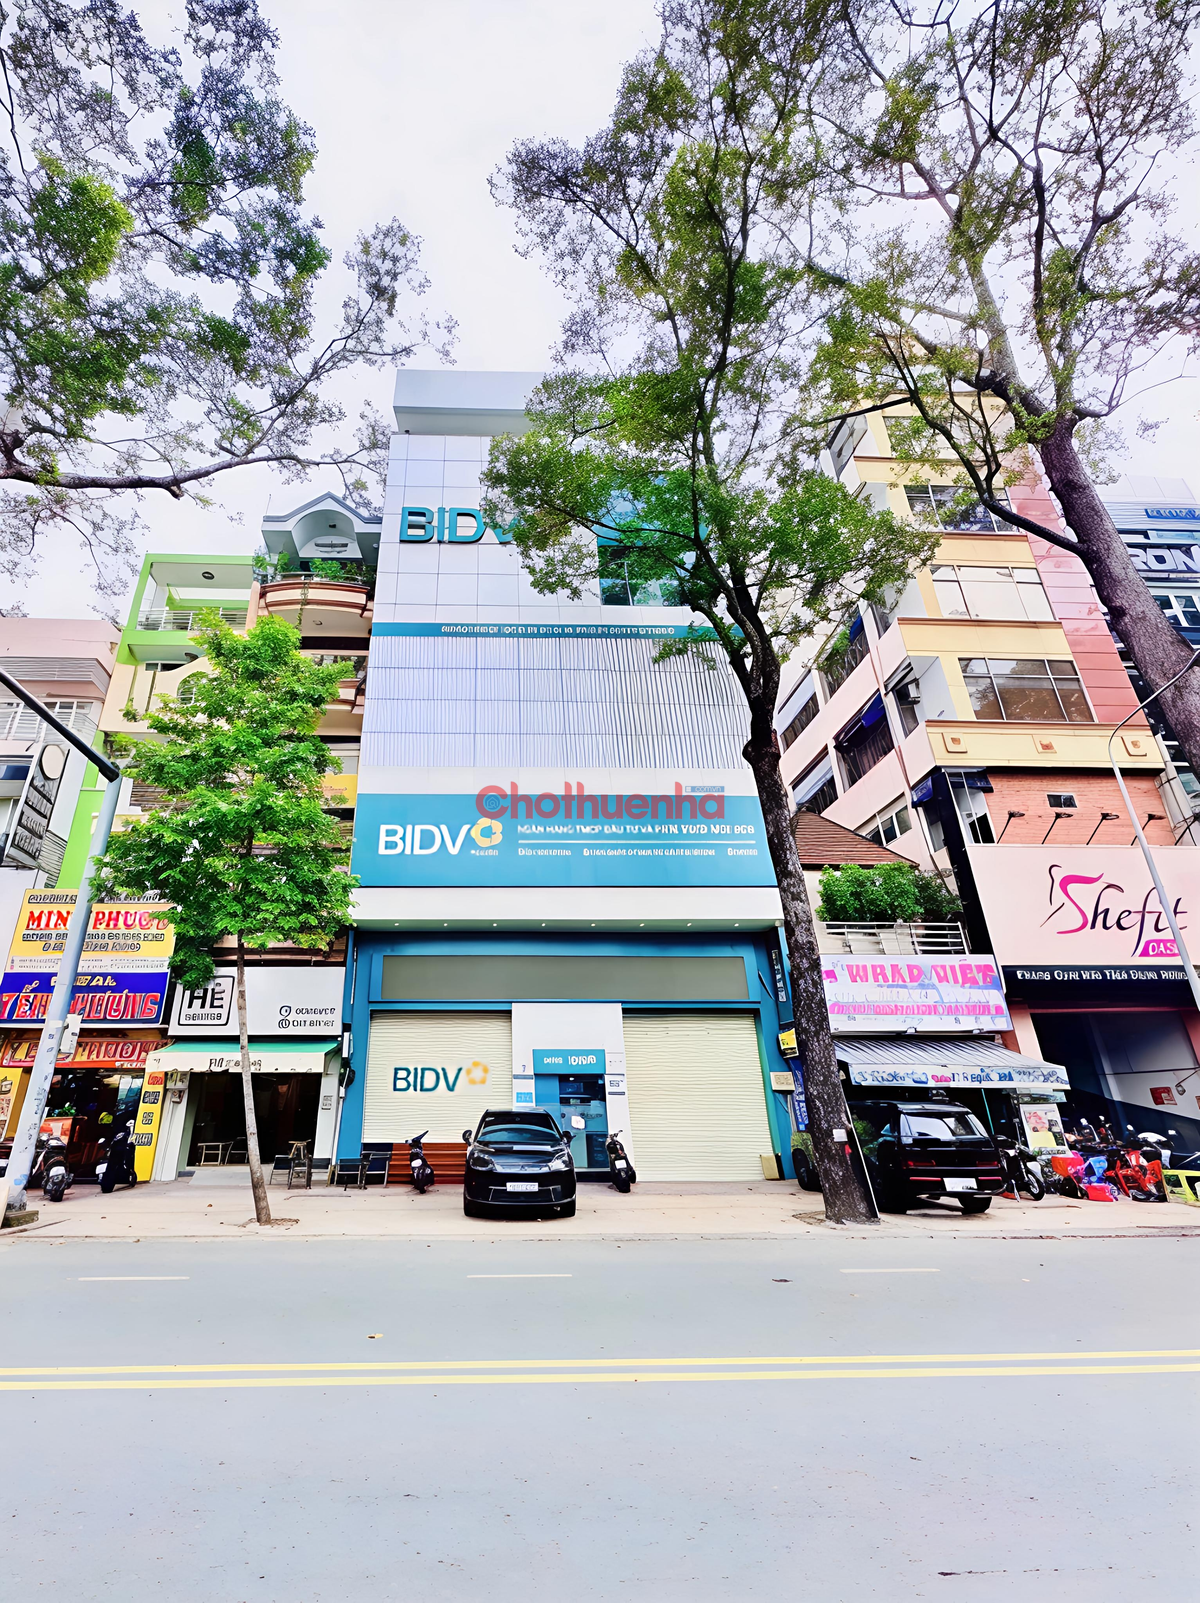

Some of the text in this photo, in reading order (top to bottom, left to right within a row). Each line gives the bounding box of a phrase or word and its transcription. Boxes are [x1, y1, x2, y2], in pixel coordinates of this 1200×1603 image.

[378, 824, 471, 855] BIDV
[25, 910, 74, 930] MIN
[393, 1066, 463, 1092] BIDV
